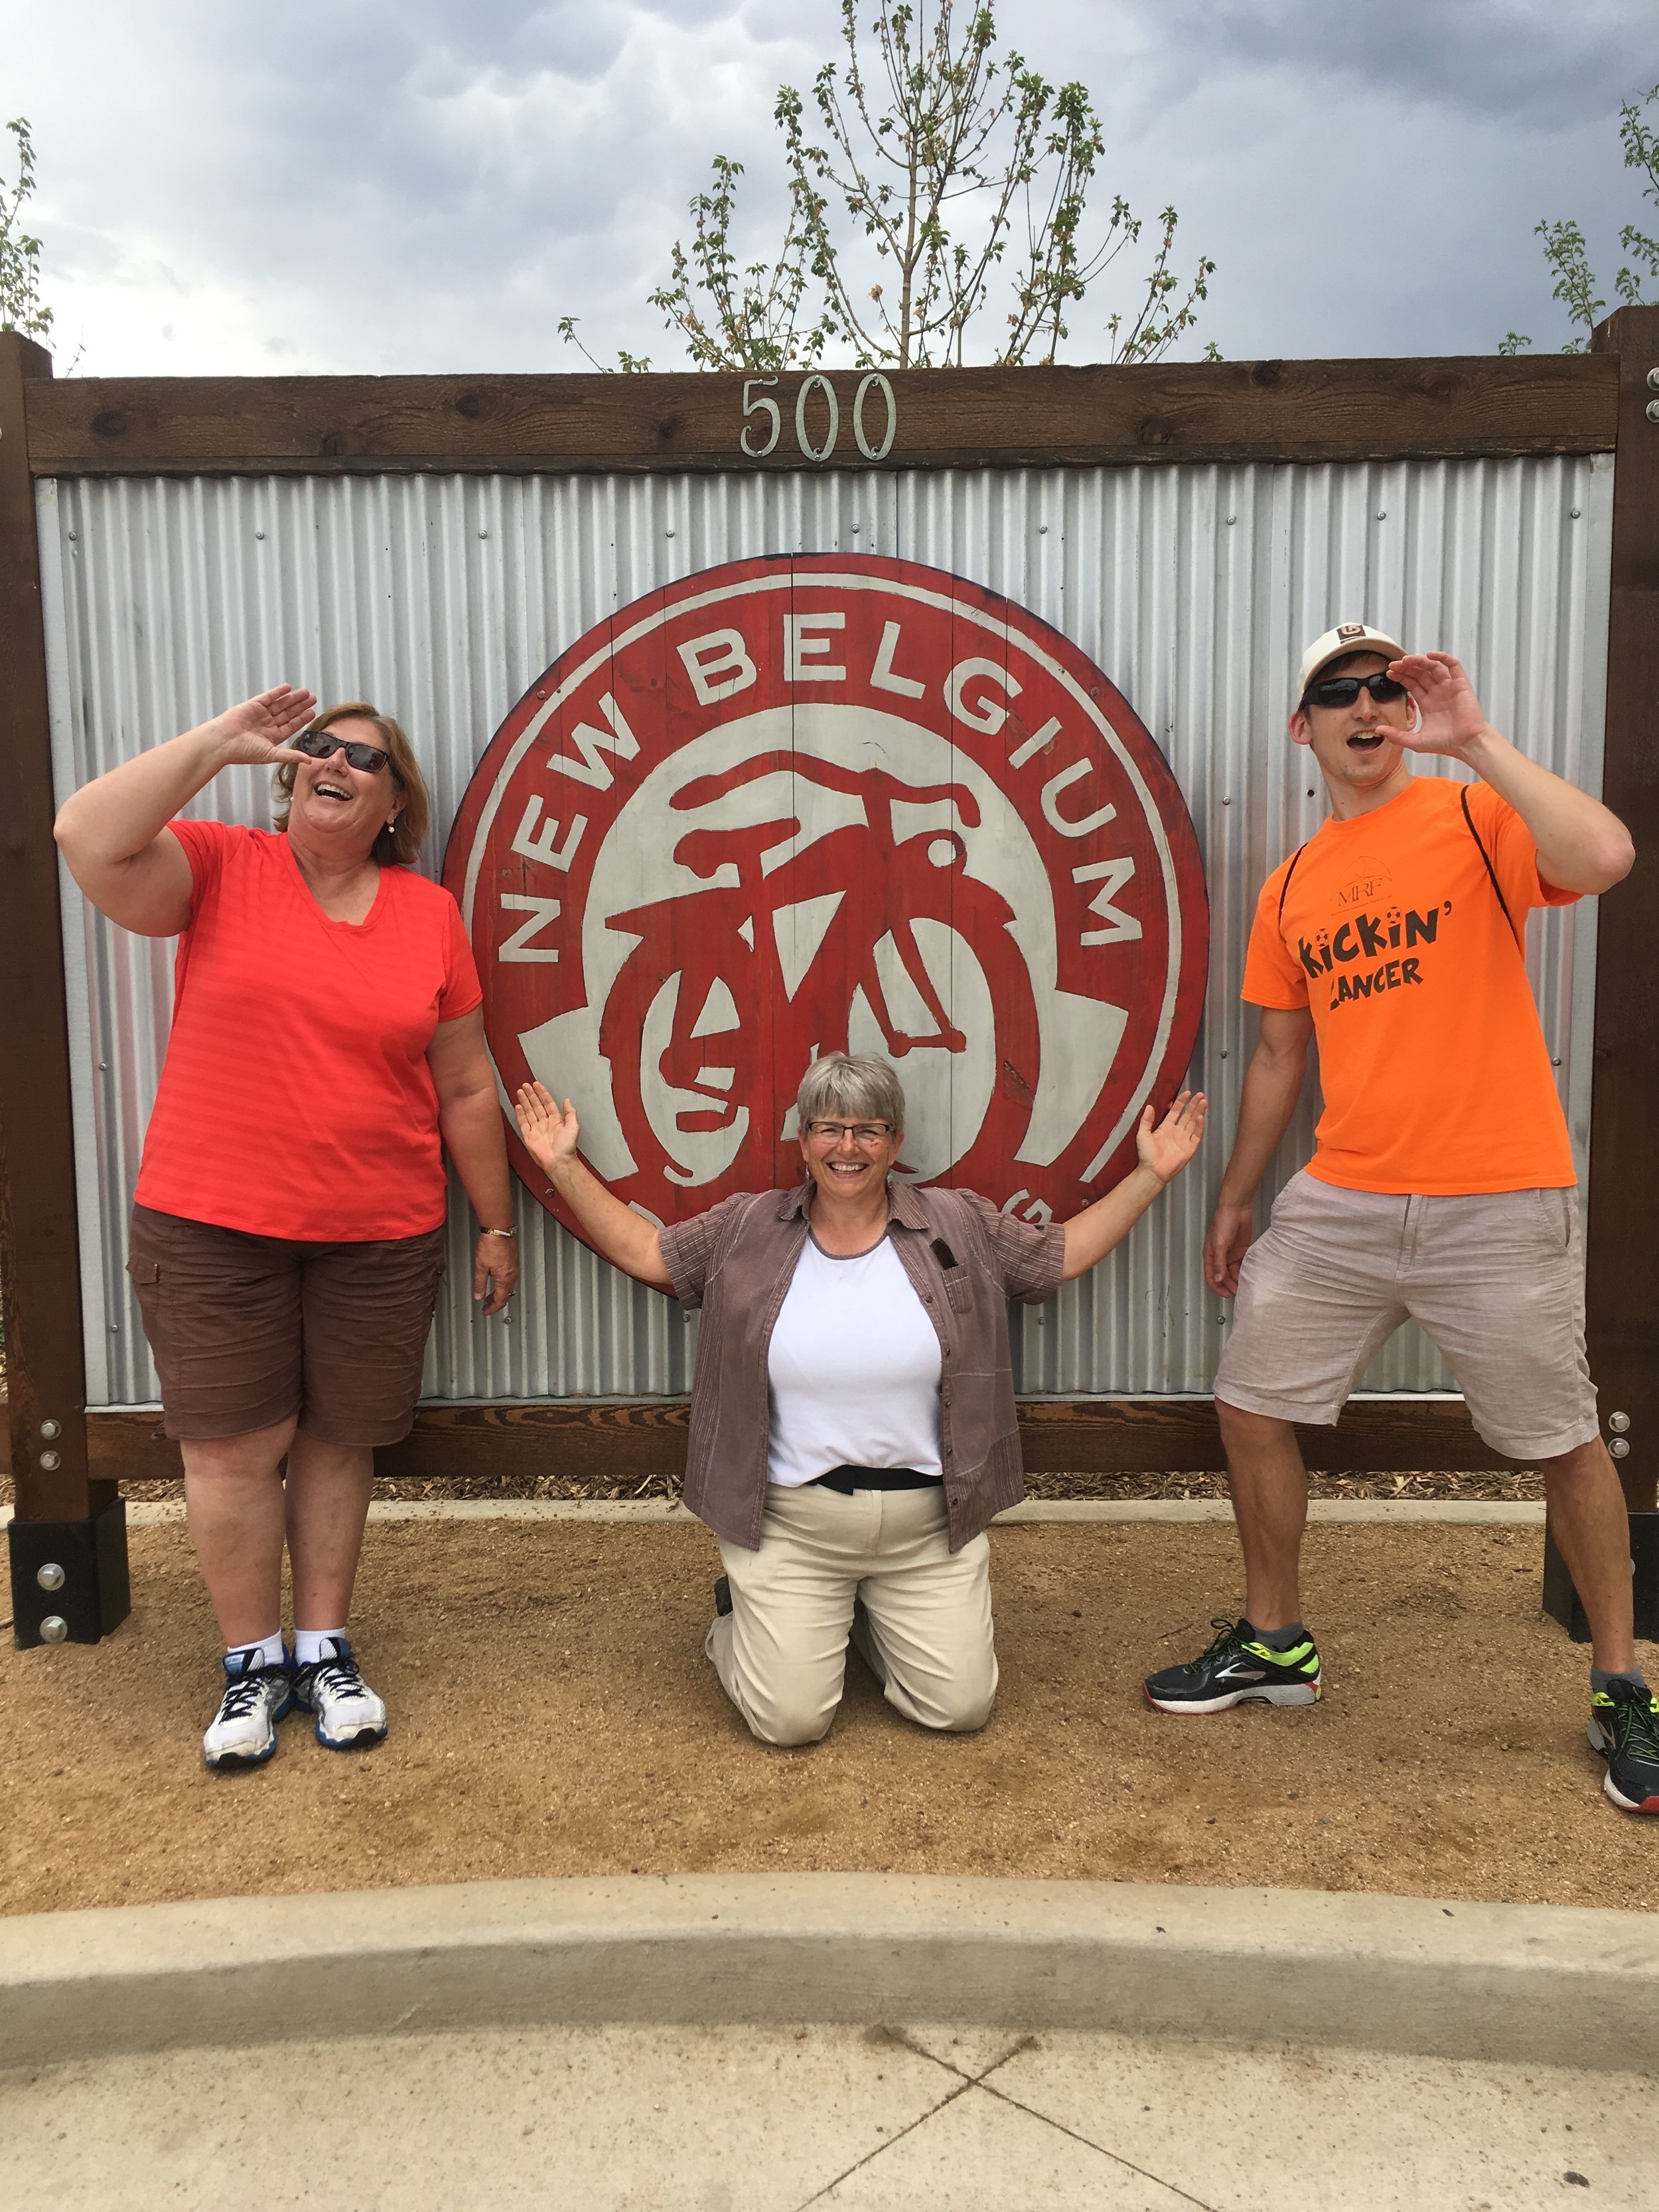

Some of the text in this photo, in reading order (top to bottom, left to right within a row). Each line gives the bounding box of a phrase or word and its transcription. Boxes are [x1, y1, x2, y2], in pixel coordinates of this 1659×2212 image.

[740, 372, 897, 462] 500
[498, 612, 1142, 962] NEW BELGIUM
[1337, 877, 1383, 907] MRF
